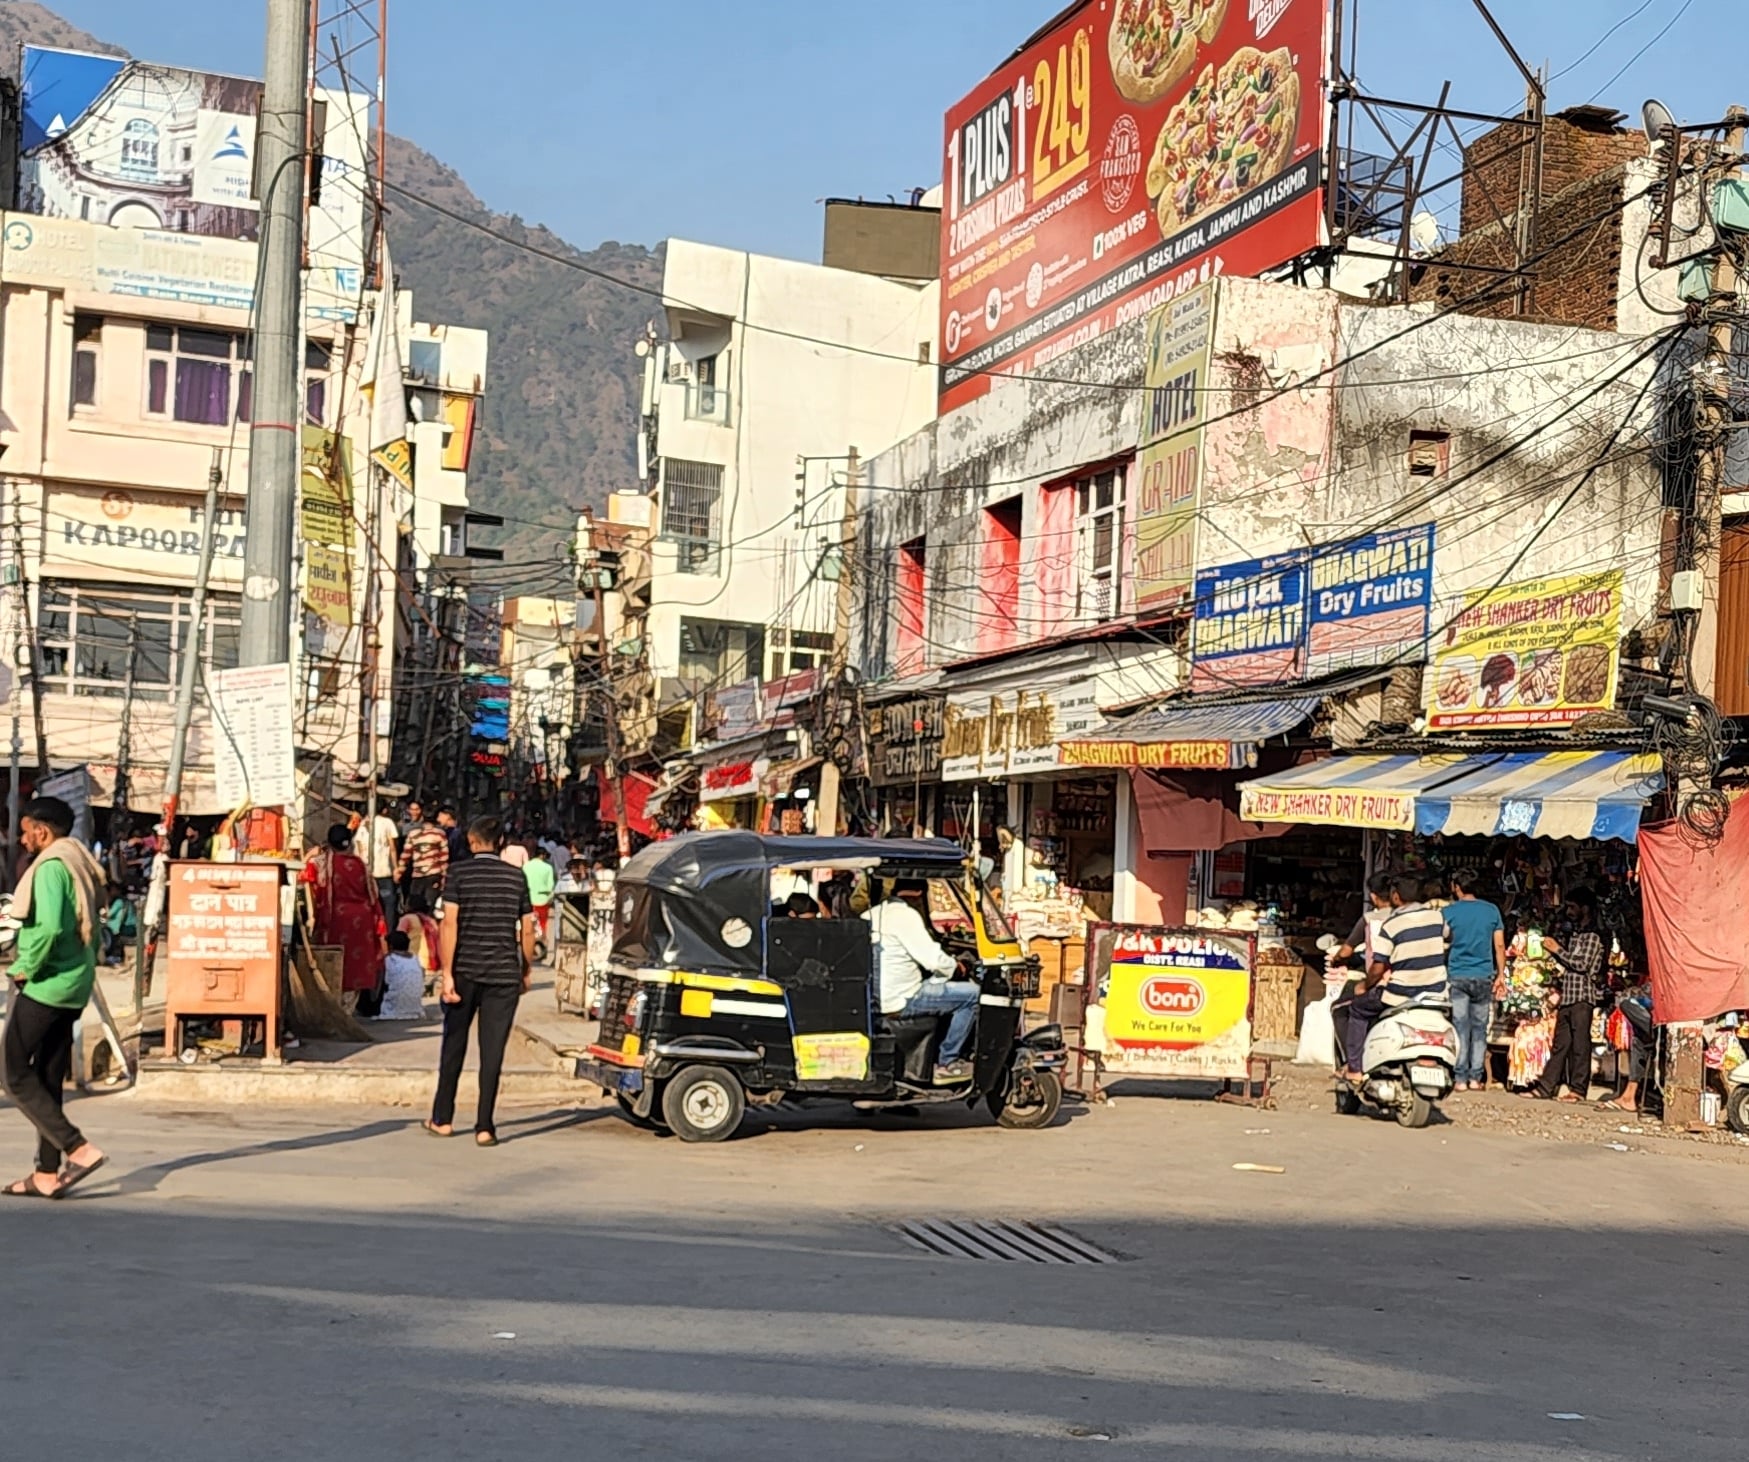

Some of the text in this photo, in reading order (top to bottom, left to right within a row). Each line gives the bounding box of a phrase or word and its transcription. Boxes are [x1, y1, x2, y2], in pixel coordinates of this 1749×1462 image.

[948, 128, 960, 221] 1
[964, 97, 1010, 207] PLUS
[1013, 75, 1026, 175] 1
[1033, 28, 1090, 186] 249
[1127, 211, 1147, 237] VEG
[1043, 301, 1076, 333] SITUATED
[1076, 295, 1086, 315] AT
[1086, 276, 1118, 309] VILLAGE
[1207, 214, 1241, 242] JAMMU
[1241, 194, 1263, 222] AND
[1263, 166, 1309, 210] KASHMIR
[209, 281, 253, 294] Restauran
[1115, 280, 1174, 326] DOWNLOAD
[1174, 268, 1198, 298] APP
[1152, 368, 1197, 437] HOTEL
[1142, 446, 1197, 514] GRAND
[64, 521, 246, 557] KAPOOR PA
[1312, 537, 1429, 591] BHAGWATI
[1214, 572, 1283, 614] HOTEL
[1320, 577, 1424, 616] Dry Fruits
[1487, 598, 1540, 626] SHANKER
[1543, 595, 1568, 620] DRY
[1569, 590, 1612, 616] FRUITS
[1195, 601, 1303, 655] BHAGWATI
[1137, 743, 1169, 765] DRY
[1170, 743, 1227, 766] FRUITS
[1256, 793, 1400, 820] NEW SHANKER DRY FRUITS
[1131, 1020, 1146, 1031] We
[1148, 1021, 1168, 1032] Care
[1187, 1023, 1202, 1033] You
